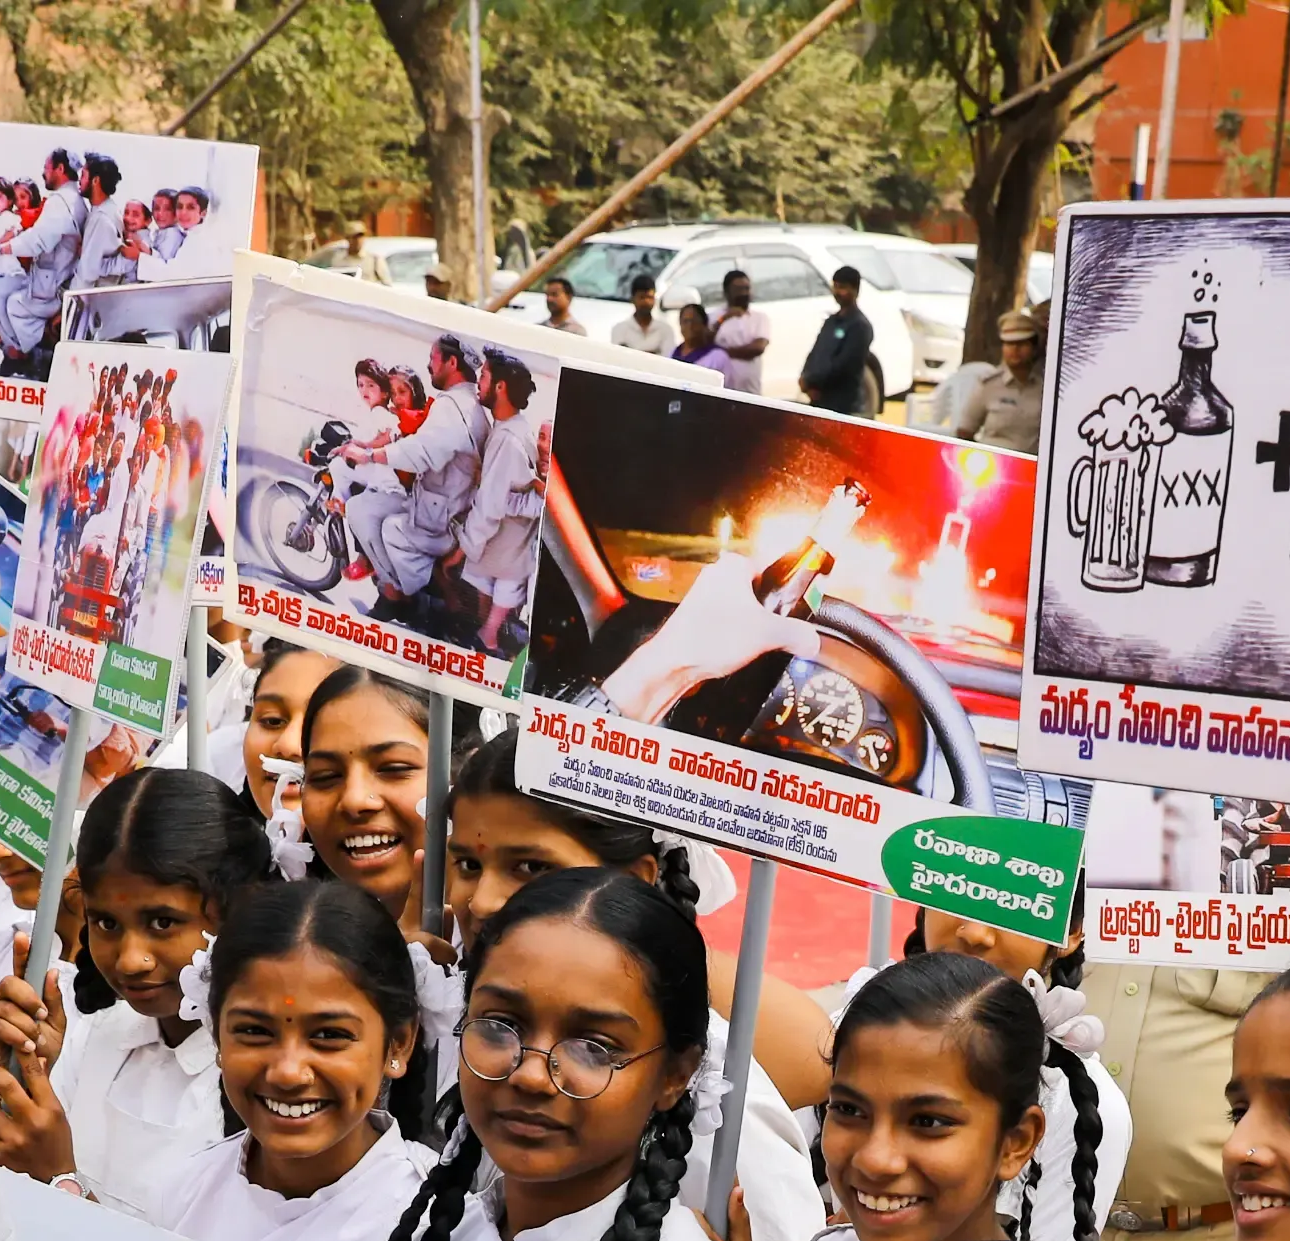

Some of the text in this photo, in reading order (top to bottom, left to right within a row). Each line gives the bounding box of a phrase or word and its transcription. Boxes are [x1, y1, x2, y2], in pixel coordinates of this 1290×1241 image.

[238, 583, 303, 626] ద్విచక్ర
[307, 602, 398, 655] వాహనం
[1039, 685, 1110, 760] మద్యం
[1118, 684, 1202, 751] సేవించి
[591, 721, 660, 765] సేవించి
[669, 748, 758, 792] వాహనం
[760, 769, 881, 826] నడుపరాదు
[811, 824, 827, 840] 185
[914, 829, 1064, 888] రవాణా శాఖ
[910, 861, 1056, 920] హైదరాబాద్
